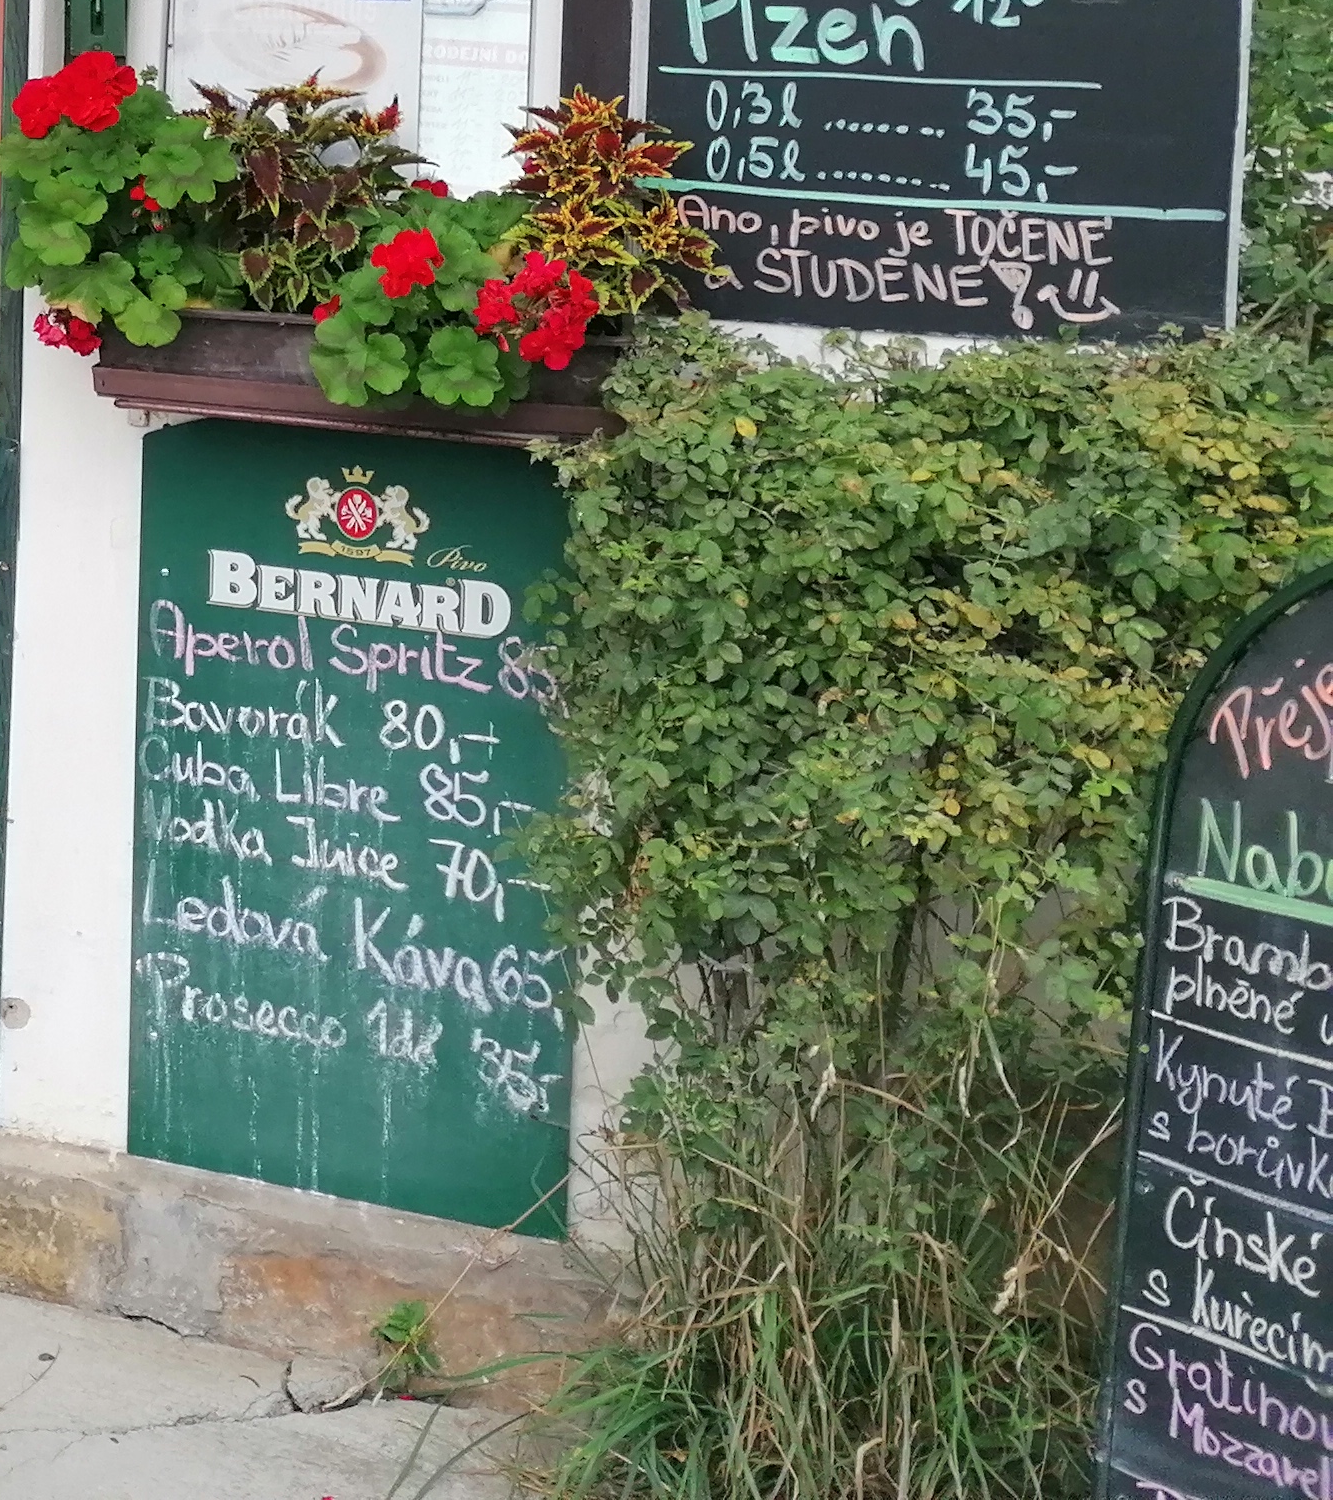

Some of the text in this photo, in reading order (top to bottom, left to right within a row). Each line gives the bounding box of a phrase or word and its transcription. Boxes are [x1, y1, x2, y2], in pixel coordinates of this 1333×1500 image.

[788, 207, 1115, 268] pivo je TOČENÉ
[206, 549, 512, 640] BERNARD
[427, 545, 489, 573] Pivo
[149, 599, 493, 693] Aperol Spritz
[143, 676, 346, 748] Bavorák
[140, 736, 401, 822] Cuba Libre
[142, 789, 409, 892] Vodka Juice
[143, 860, 493, 1012] Ledová Káva
[135, 951, 348, 1048] Prosecco
[1165, 956, 1304, 1034] plněné
[1156, 1029, 1297, 1131] Kynuté
[1164, 1171, 1320, 1298] Čínské
